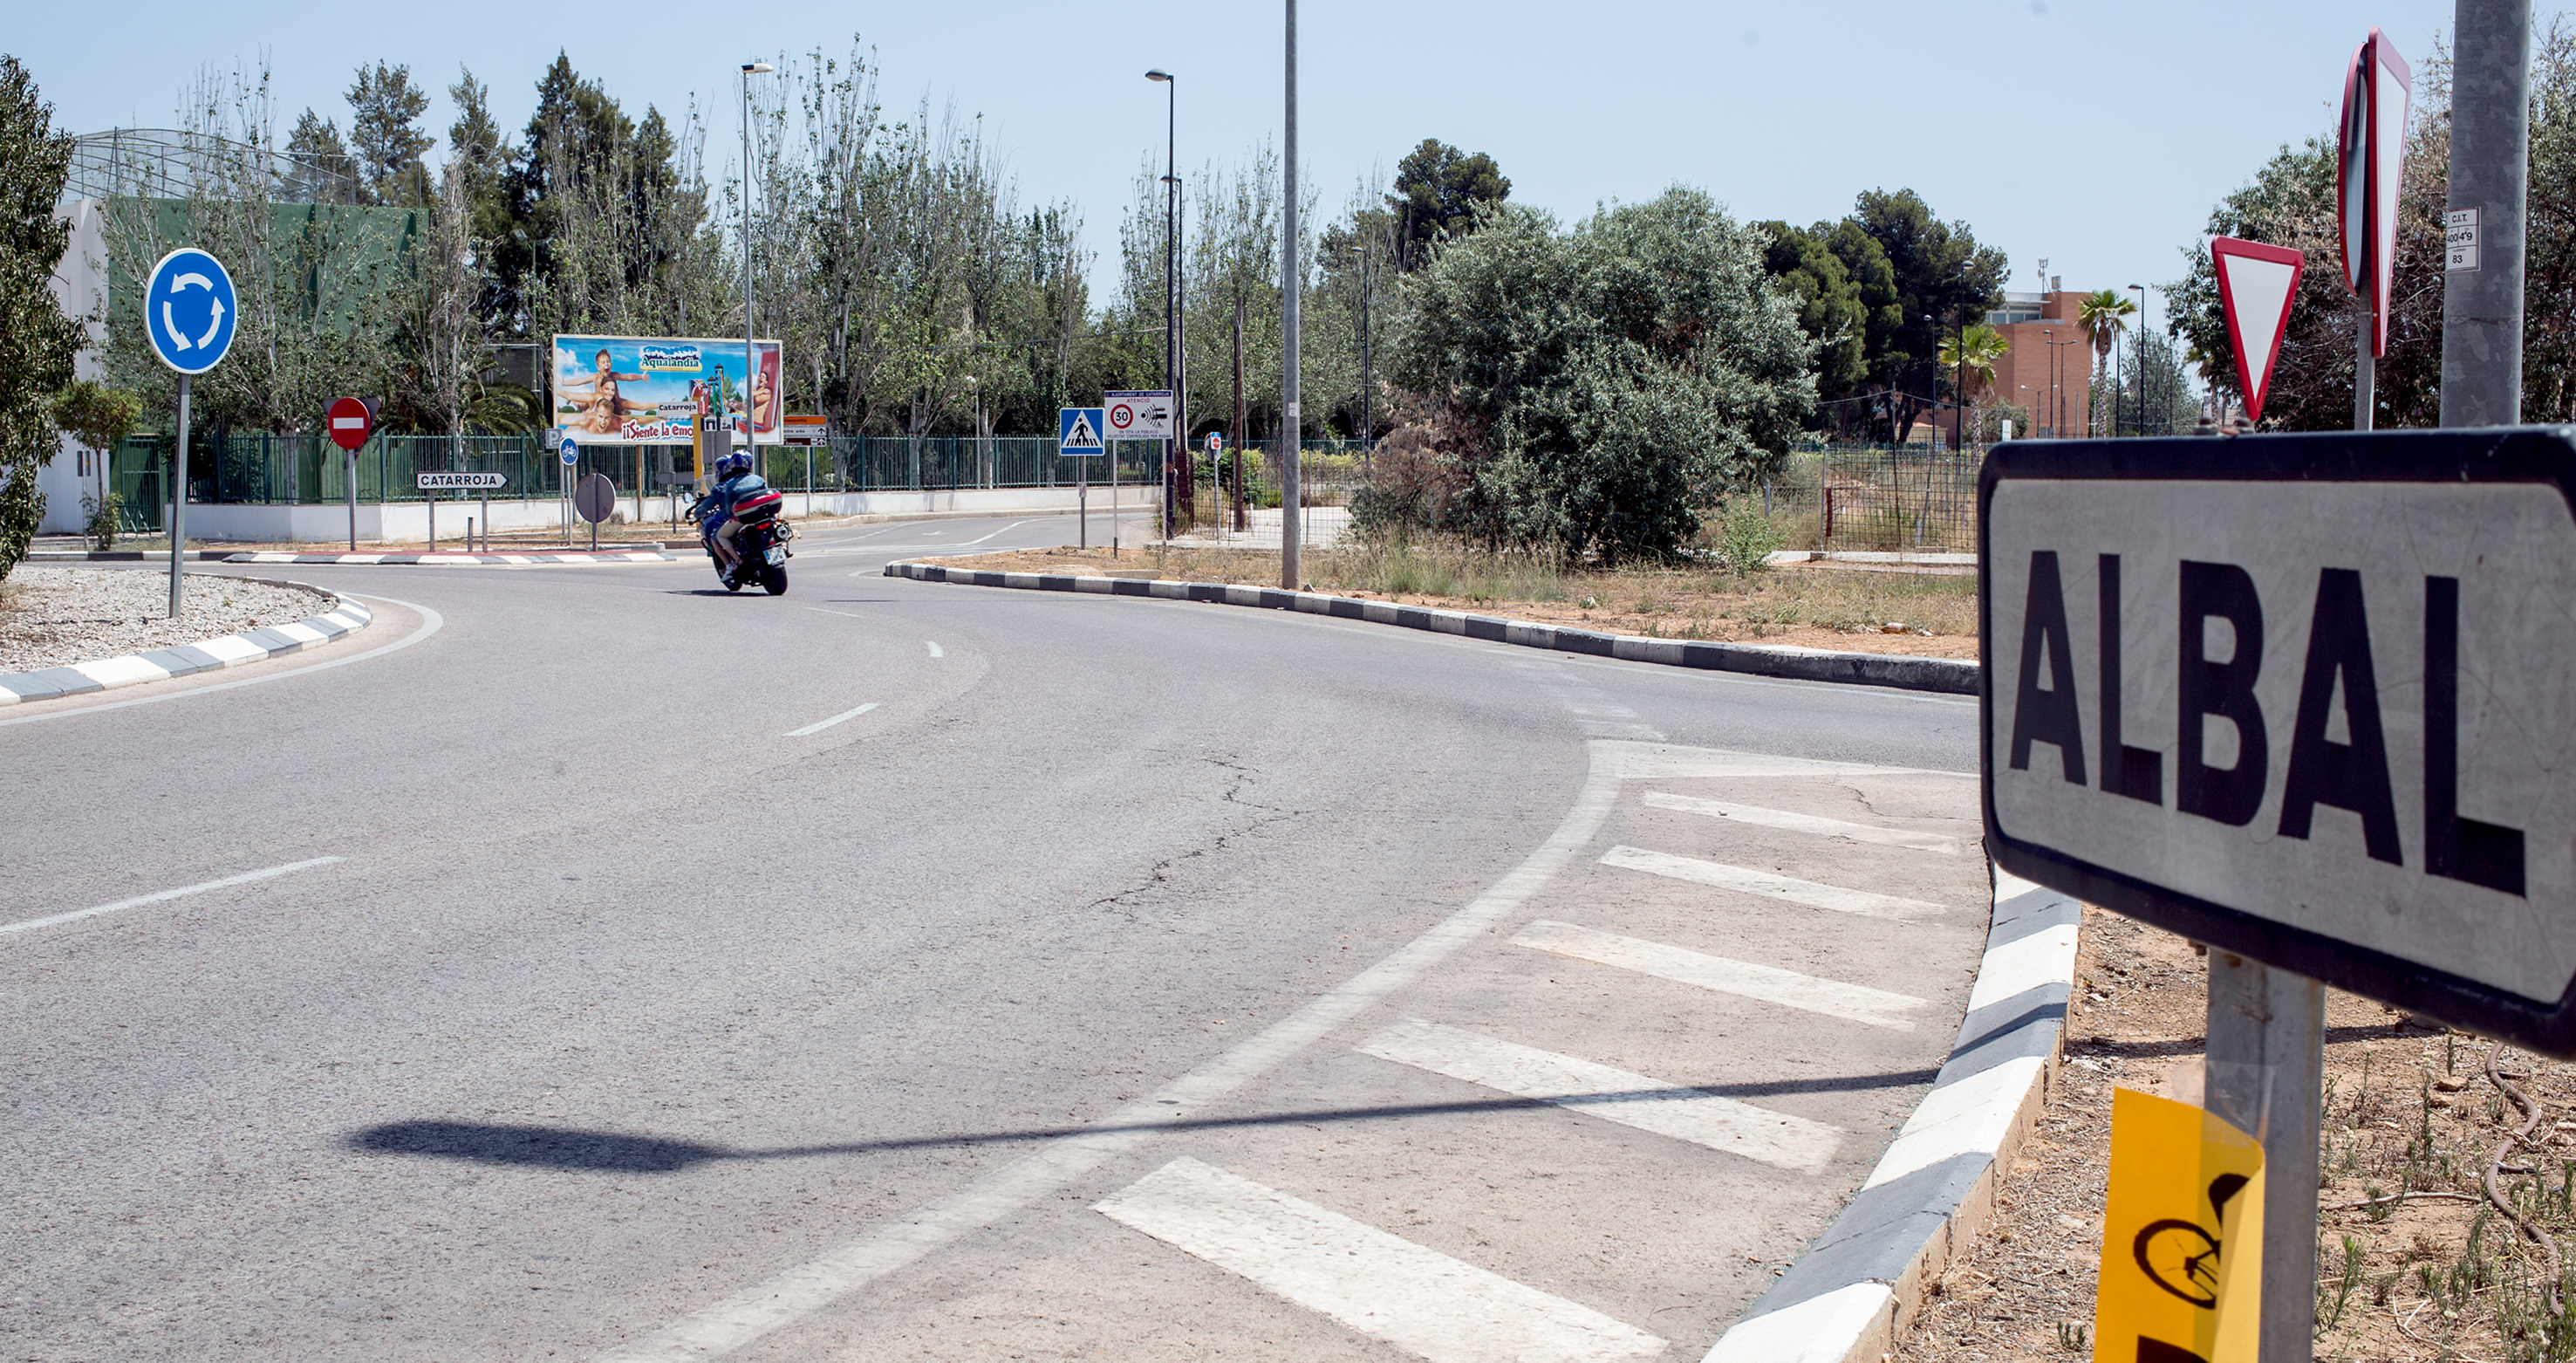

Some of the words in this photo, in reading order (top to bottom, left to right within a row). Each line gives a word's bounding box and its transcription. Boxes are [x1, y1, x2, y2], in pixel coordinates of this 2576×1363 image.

[2452, 214, 2468, 223] C.I.T.
[2452, 255, 2463, 264] 83
[641, 357, 699, 368] Aqualandia
[659, 403, 697, 412] Catarroja
[1116, 412, 1128, 421] 30
[661, 422, 670, 436] la
[672, 425, 694, 437] emo
[420, 476, 497, 485] CATARROJA
[2010, 551, 2527, 898] ALBAL
